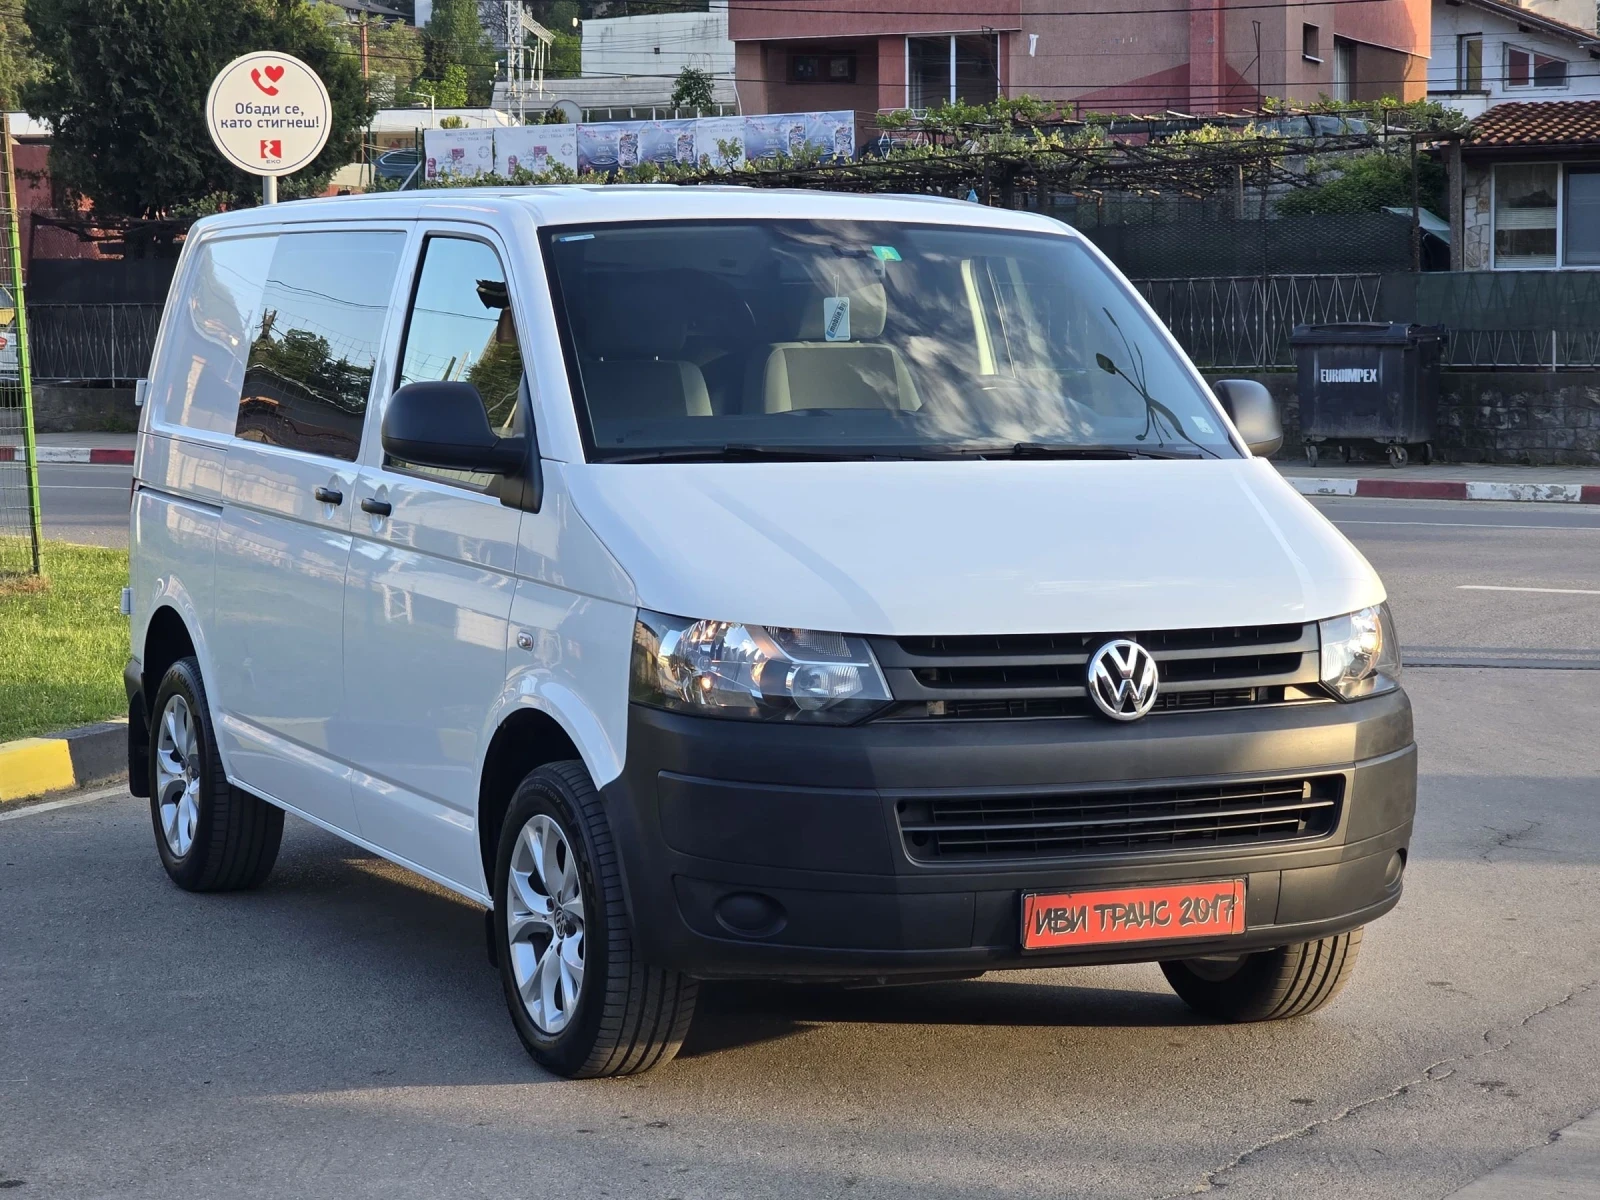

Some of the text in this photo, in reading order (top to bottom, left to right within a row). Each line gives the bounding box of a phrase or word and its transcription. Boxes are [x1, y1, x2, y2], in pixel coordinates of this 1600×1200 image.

[235, 102, 304, 116] Обади се,
[220, 116, 319, 128] като стигнеш!
[1320, 368, 1378, 383] EUROIMPEX
[1035, 893, 1239, 936] ИВИ ТРАНС 2017
